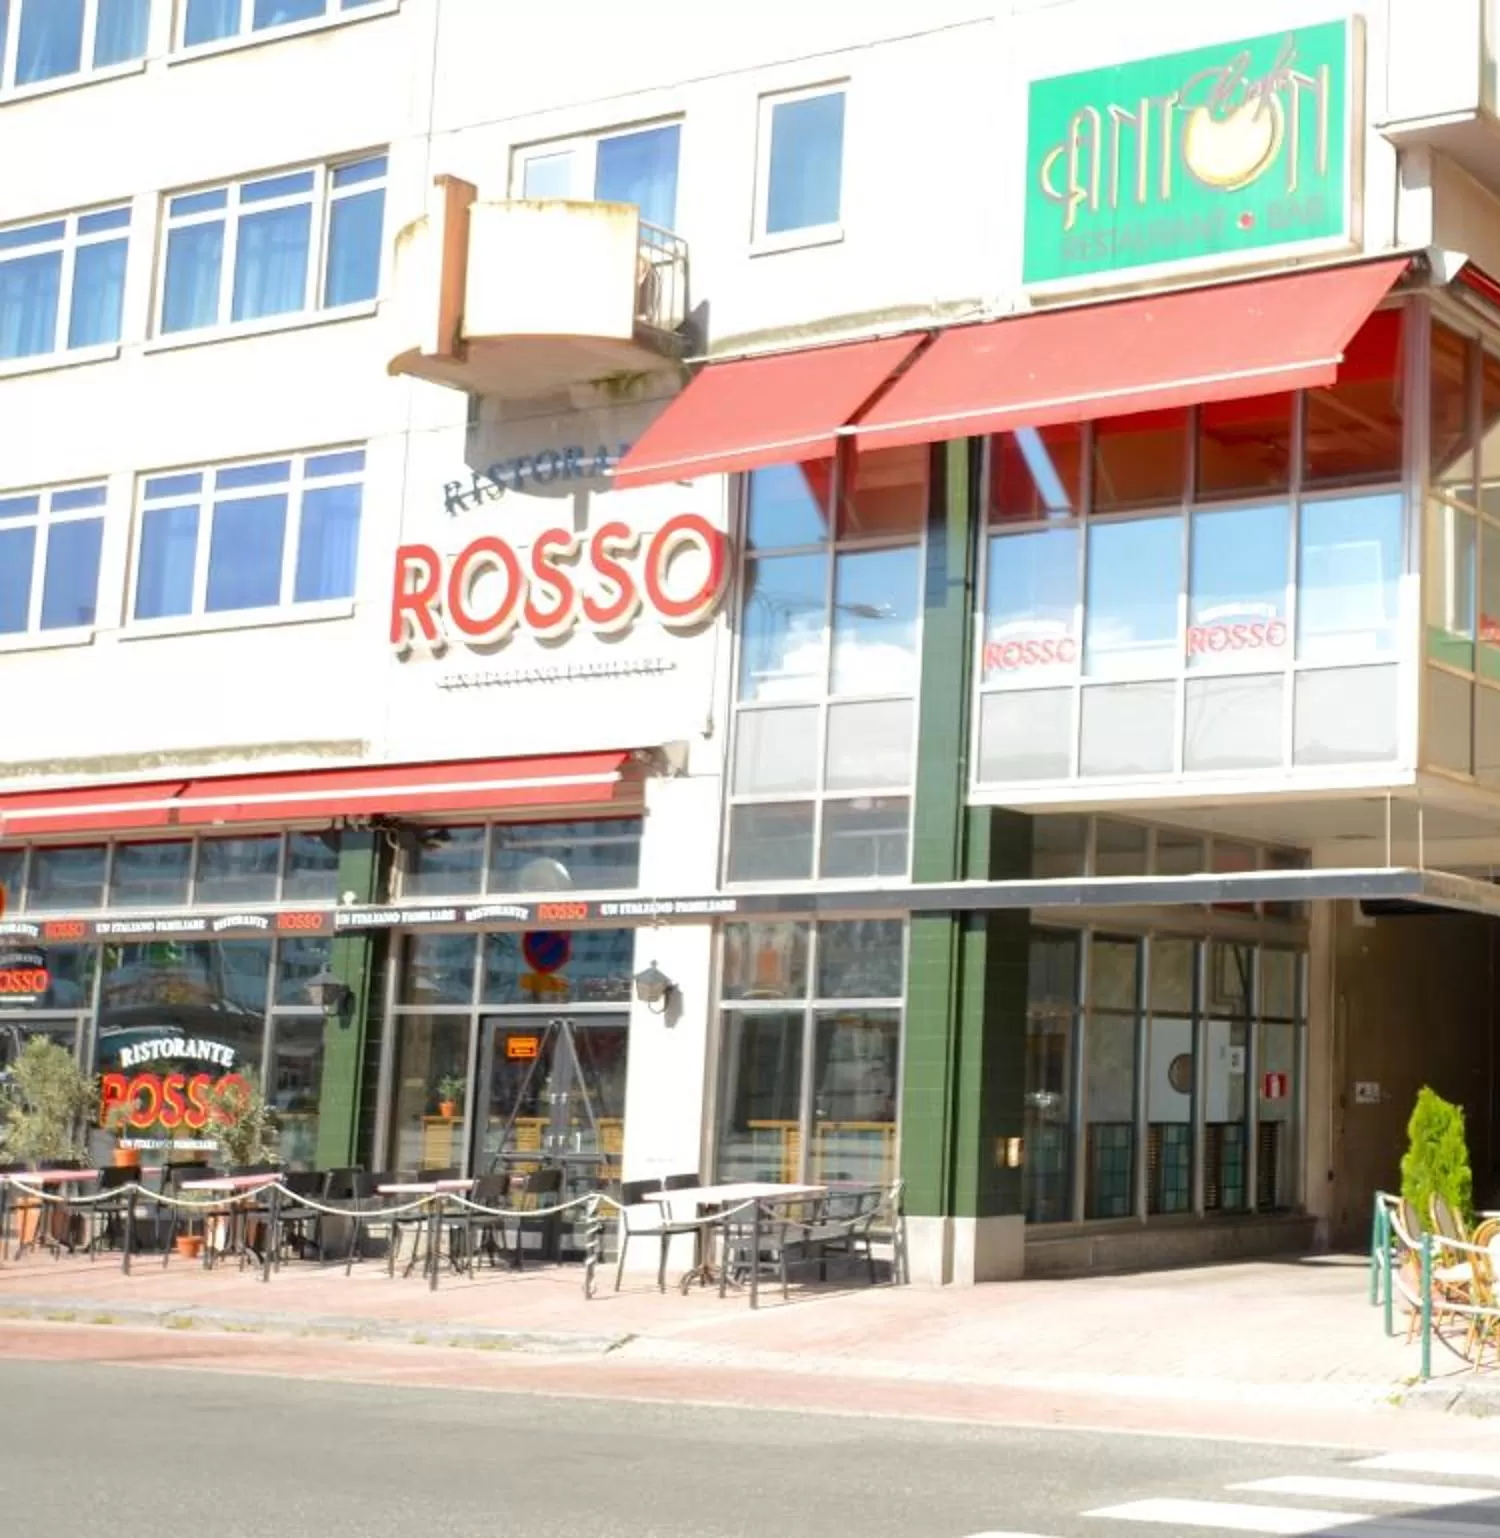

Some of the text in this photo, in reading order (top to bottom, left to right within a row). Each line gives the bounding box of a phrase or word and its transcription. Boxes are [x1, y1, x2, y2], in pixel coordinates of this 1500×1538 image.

[390, 513, 729, 644] ROSSO
[277, 912, 322, 930] ROSSO
[538, 902, 588, 920] ROSSO
[119, 1036, 236, 1068] RISTORANTE
[100, 1071, 252, 1129] ROSSO
